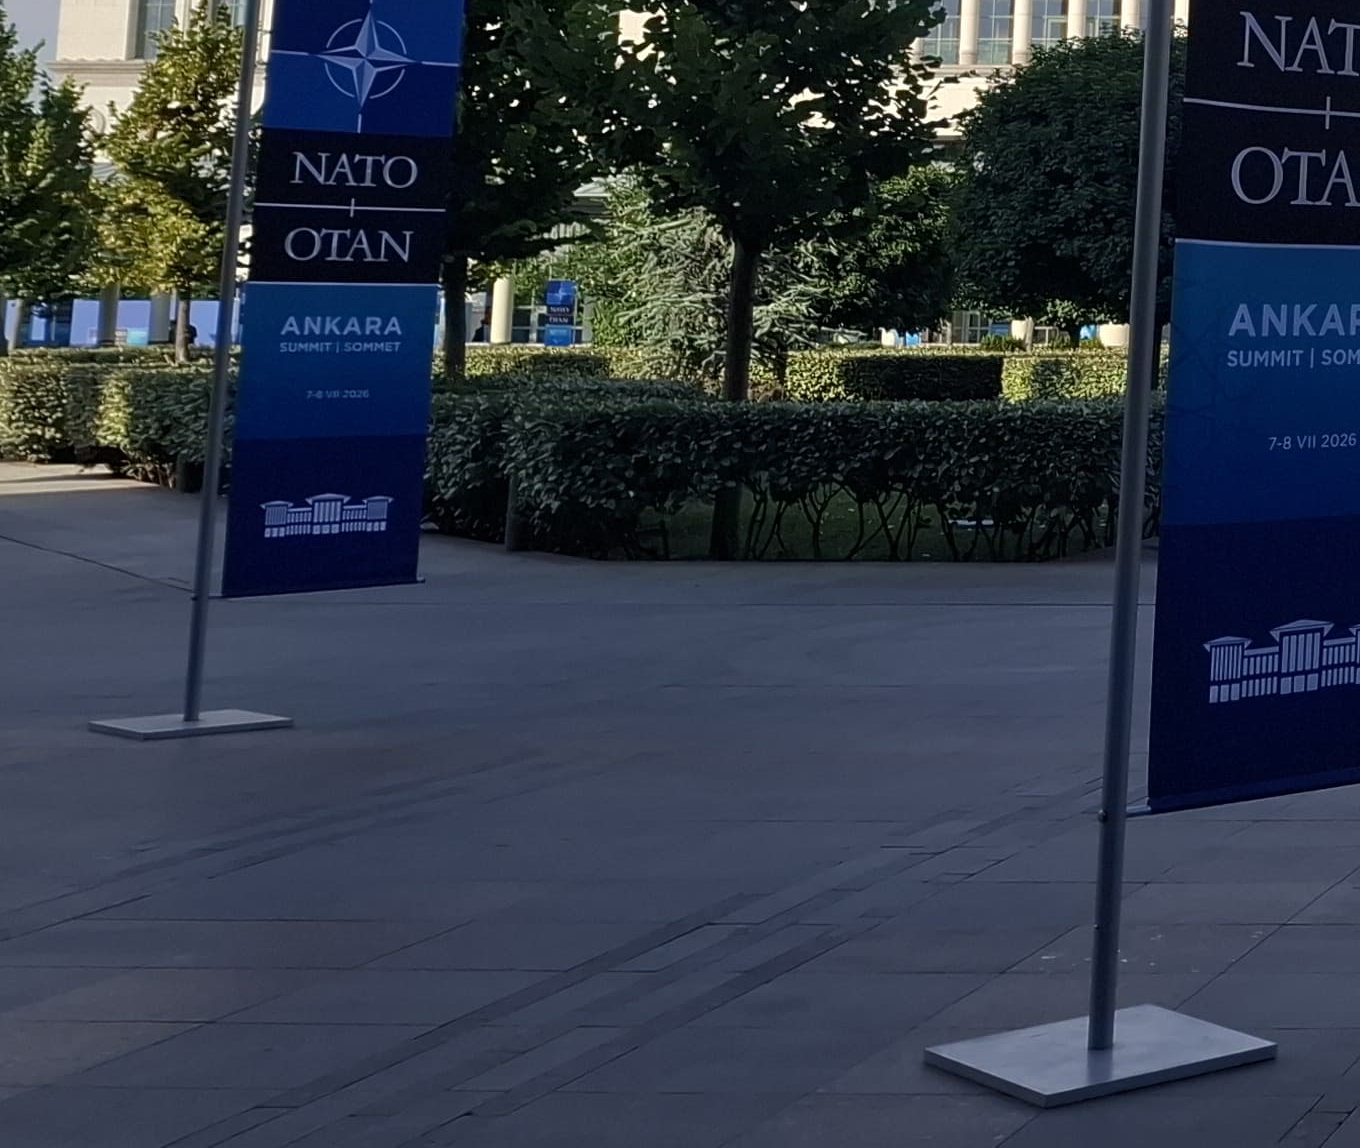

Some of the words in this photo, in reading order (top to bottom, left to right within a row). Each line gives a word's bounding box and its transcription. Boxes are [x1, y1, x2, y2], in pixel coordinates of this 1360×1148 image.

[290, 152, 418, 189] NATO
[284, 227, 414, 263] OTAN
[281, 316, 402, 336] ANKARA
[280, 342, 332, 353] SUMMIT
[344, 341, 402, 353] SOMMET
[1227, 350, 1304, 368] SUMMIT
[342, 389, 370, 399] 2026
[1268, 436, 1292, 451] 7-8
[1297, 435, 1316, 449] VII
[1321, 433, 1357, 448] 2026
